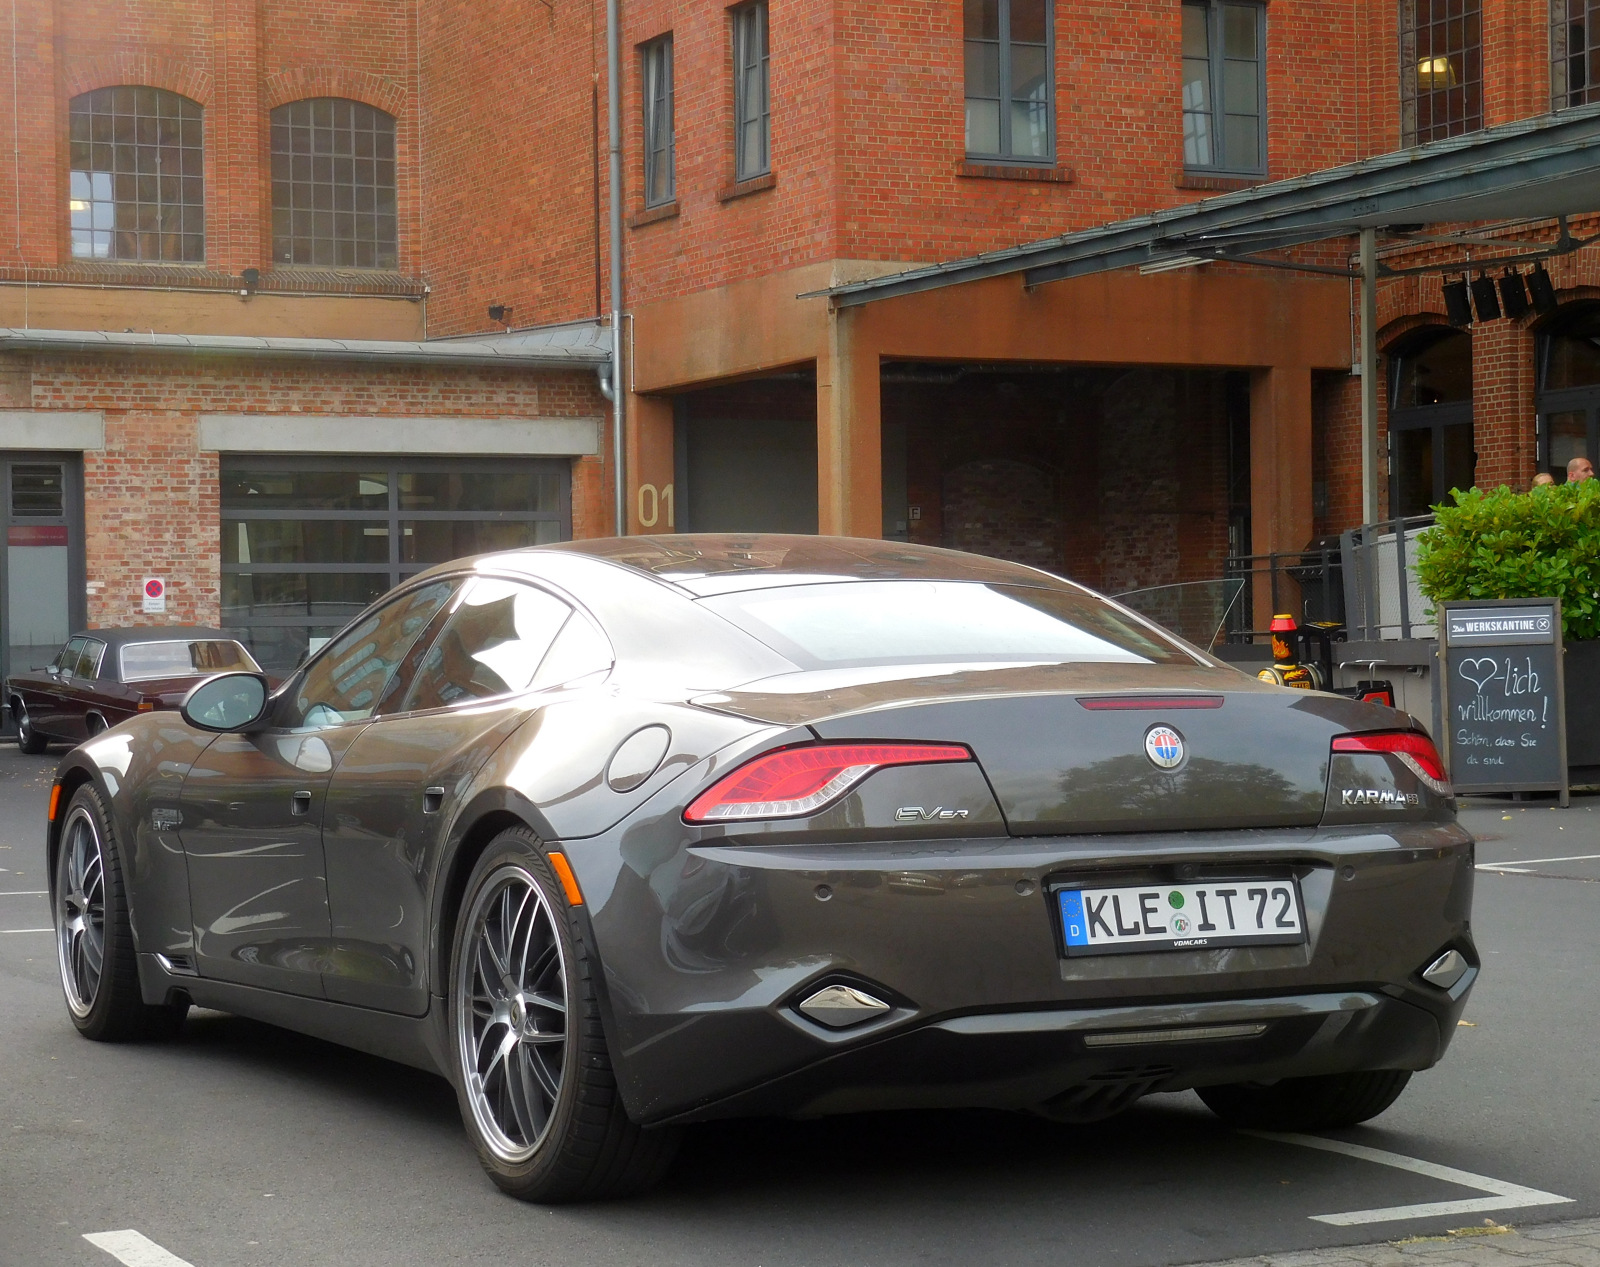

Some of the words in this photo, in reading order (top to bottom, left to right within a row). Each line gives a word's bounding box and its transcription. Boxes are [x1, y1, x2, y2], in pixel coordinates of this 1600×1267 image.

[638, 483, 674, 527] 01
[1465, 620, 1535, 633] WERKSKANTINE
[1341, 788, 1407, 806] KARMA
[1085, 892, 1168, 938] KLE
[1070, 924, 1080, 937] D
[1173, 938, 1208, 948] VDMCARS
